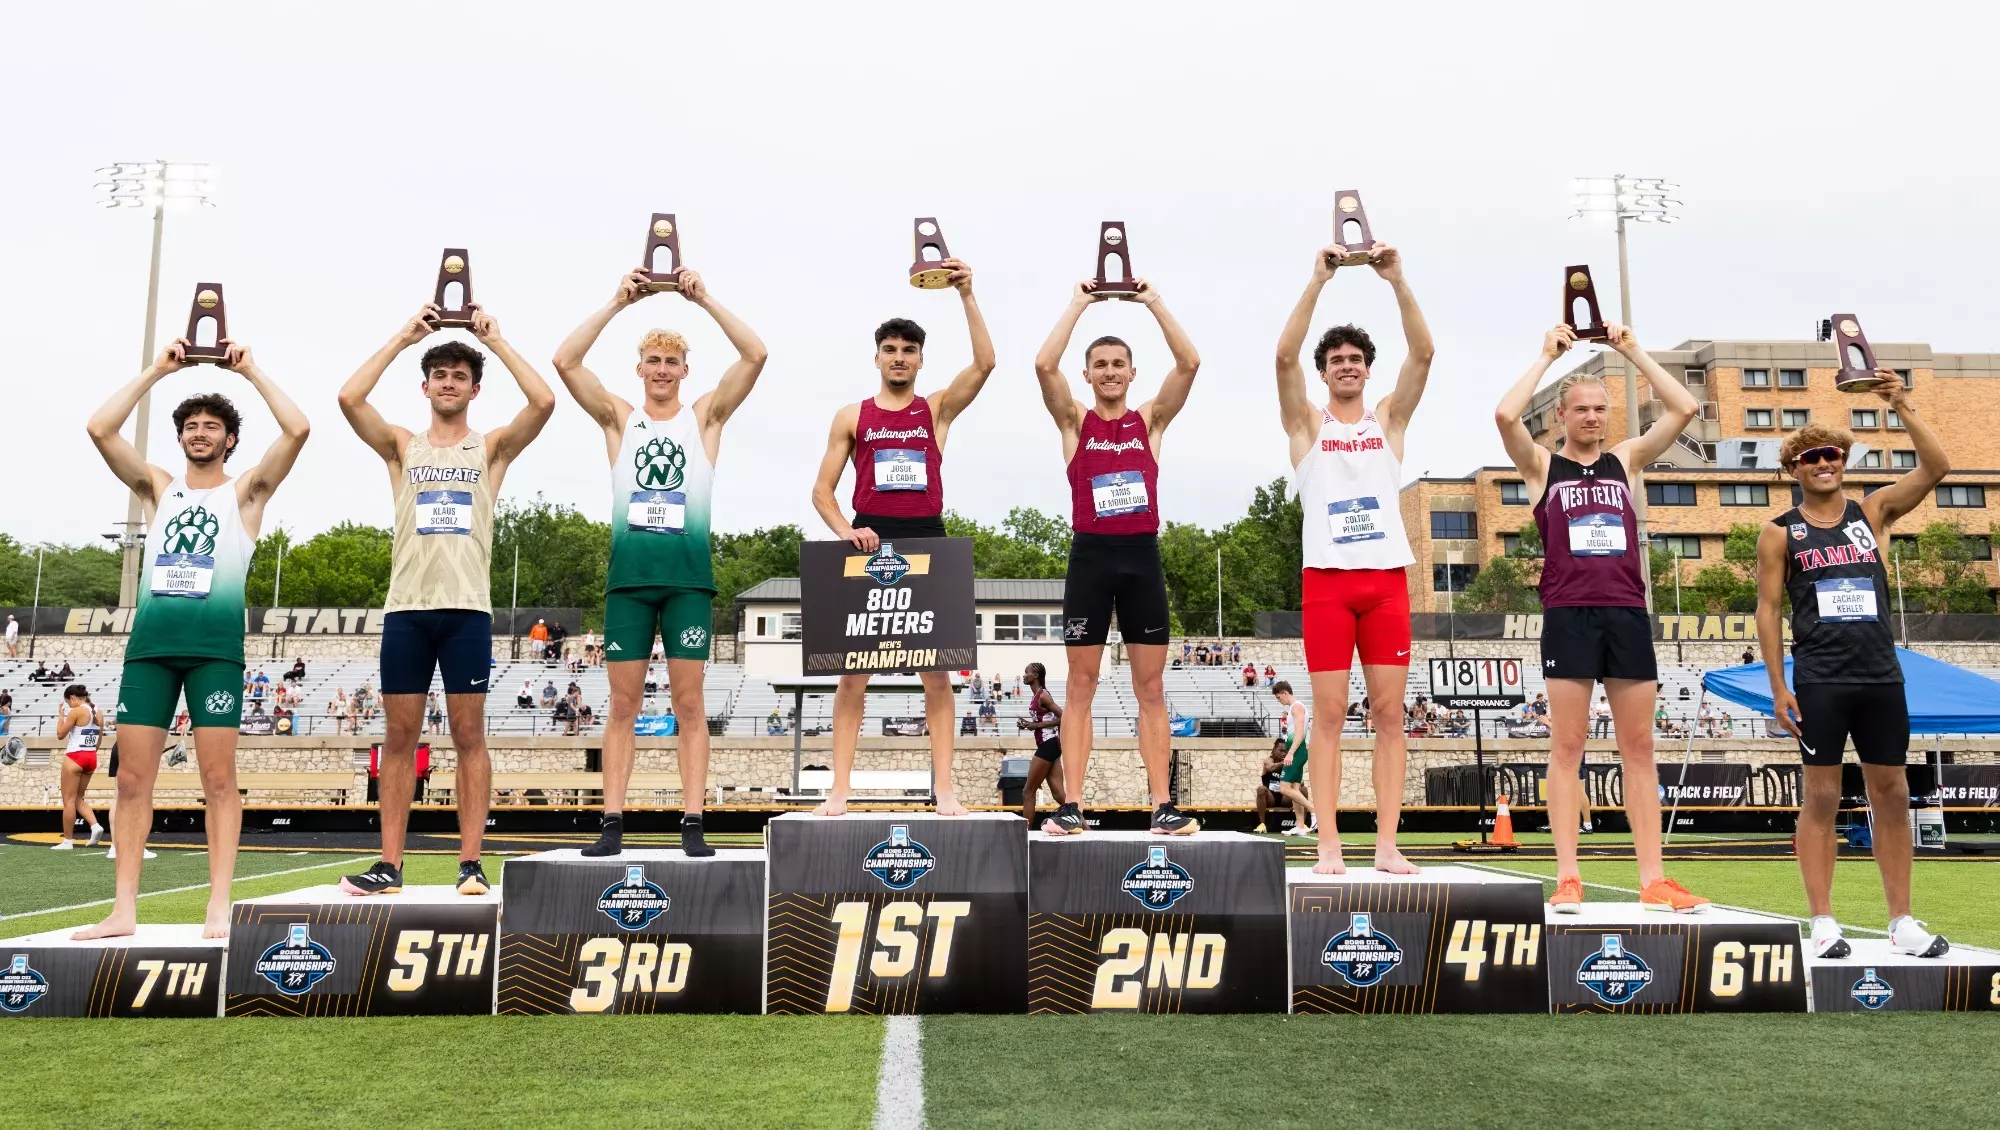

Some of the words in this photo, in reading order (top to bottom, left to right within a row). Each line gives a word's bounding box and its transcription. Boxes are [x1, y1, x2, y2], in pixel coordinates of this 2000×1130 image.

[864, 426, 928, 442] Indianapolis
[891, 464, 912, 472] JOSUE
[408, 466, 481, 484] WINGATE
[886, 474, 894, 482] LE
[896, 474, 916, 482] CADRE
[1110, 488, 1131, 497] YANIS
[1560, 487, 1588, 512] WEST
[1591, 486, 1624, 510] TEXAS
[1098, 500, 1106, 509] LE
[433, 507, 456, 516] KLAUS
[647, 506, 666, 515] RILEY
[430, 516, 458, 525] SCHOLZ
[647, 516, 665, 524] WITT
[1345, 514, 1370, 524] COLTON
[1343, 523, 1375, 534] PLUMMER
[1591, 530, 1607, 538] EMIL
[1852, 526, 1871, 550] 8
[166, 570, 197, 579] MAXIME
[166, 579, 196, 589] TOURON
[866, 587, 912, 611] 800
[1832, 594, 1864, 604] ZACHARY
[1836, 604, 1864, 613] KEHLER
[846, 611, 934, 636] METERS
[878, 641, 901, 649] MEN'S
[845, 649, 937, 670] CHAMPION
[1667, 786, 1701, 798] TRACK
[1702, 786, 1711, 798] &
[1712, 786, 1742, 798] FIELD
[1958, 787, 1966, 799] &
[1968, 787, 1997, 799] FIELD
[866, 859, 933, 868] CHAMPIONSHIPS
[1124, 880, 1192, 889] CHAMPIONSHIPS
[600, 900, 668, 909] CHAMPIONSHIPS
[1445, 920, 1540, 982] 4TH
[387, 930, 490, 992] 5TH
[825, 901, 971, 1012] 1ST
[1325, 952, 1400, 962] CHAMPIONSHIPS
[258, 962, 334, 971] CHAMPIONSHIPS
[1091, 928, 1227, 1009] 2ND
[1710, 942, 1794, 997] 6TH
[569, 937, 692, 1012] 3RD
[1580, 972, 1650, 980] CHAMPIONSHIPS
[0, 985, 46, 993] AMPIONSHIPS
[131, 960, 208, 1008] 7TH
